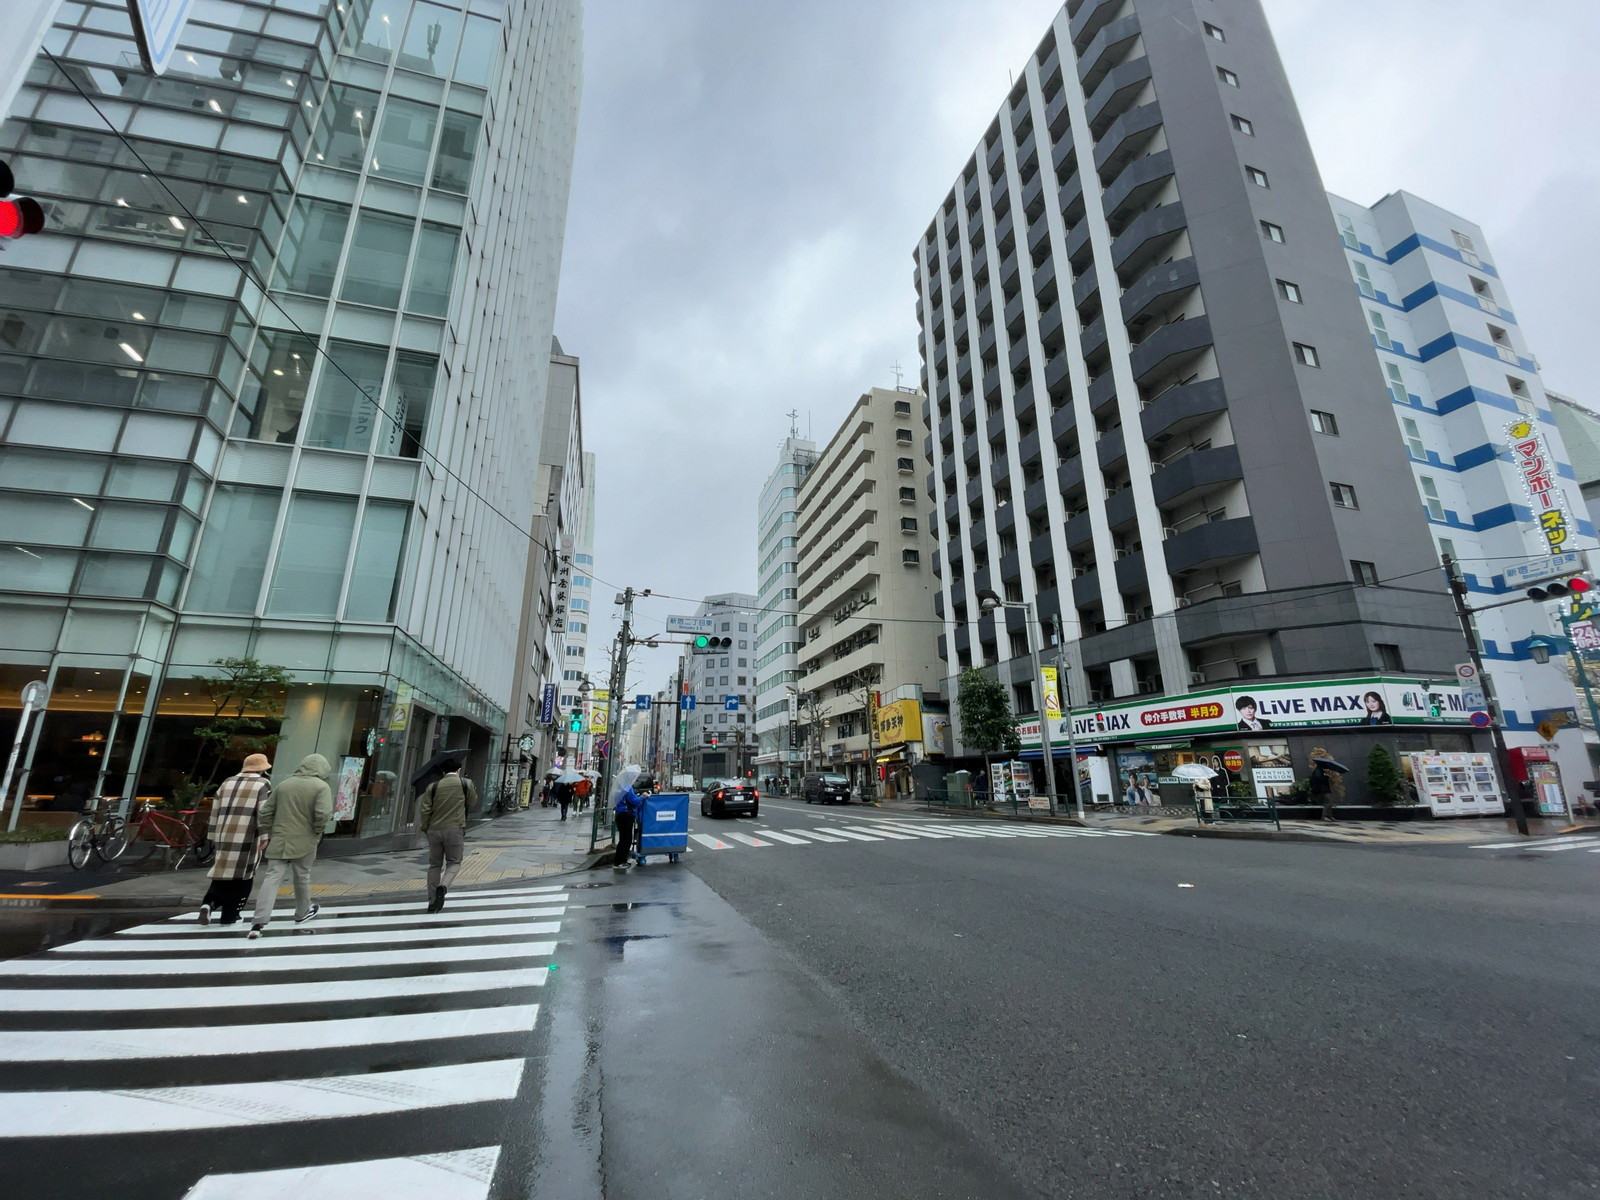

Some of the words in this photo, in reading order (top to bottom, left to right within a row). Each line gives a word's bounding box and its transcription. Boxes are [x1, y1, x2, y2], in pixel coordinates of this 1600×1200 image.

[1514, 438, 1553, 508] マンボー
[1507, 553, 1577, 577] 新宿二丁目東
[670, 617, 713, 626] 新宿二丁目東
[1259, 699, 1306, 715] LiVE
[1310, 695, 1363, 712] MAX
[1413, 692, 1446, 711] LE
[1144, 709, 1187, 724] 仲介手数料
[1190, 705, 1219, 718] 半月分
[1072, 718, 1096, 735] iVE
